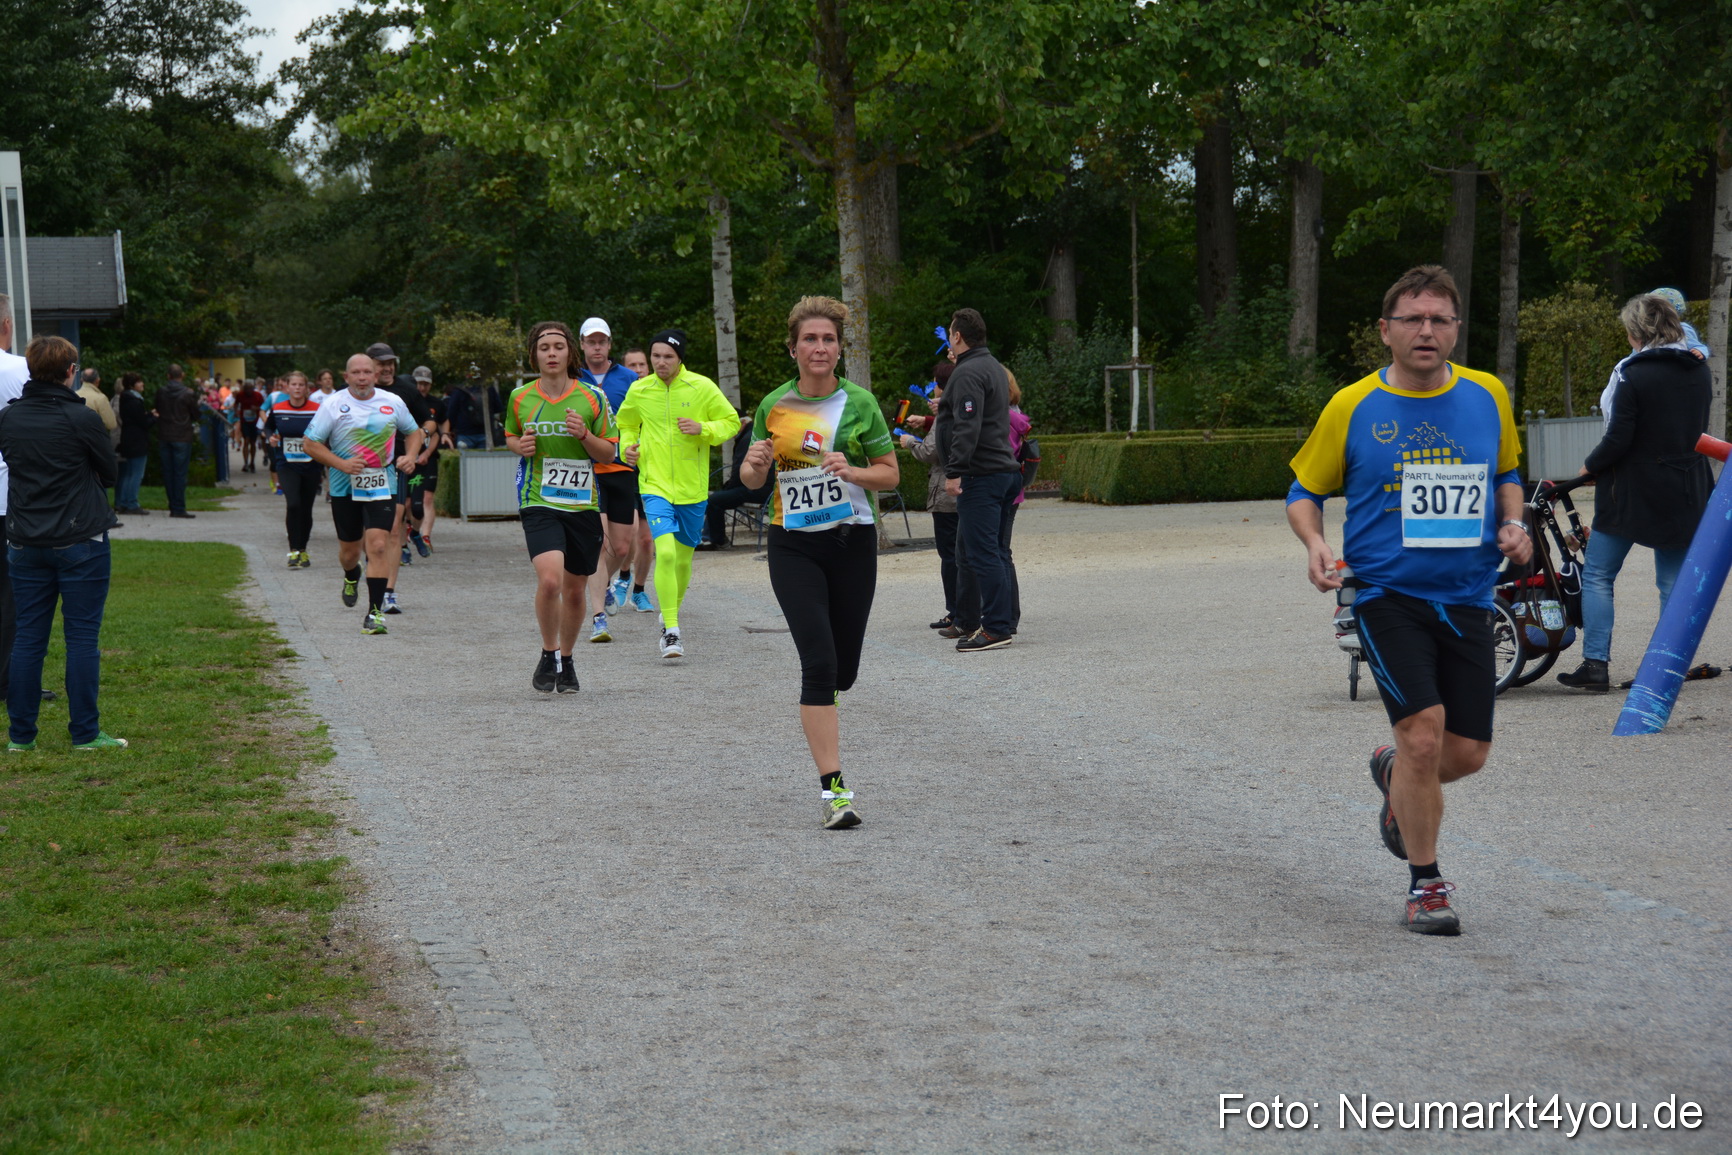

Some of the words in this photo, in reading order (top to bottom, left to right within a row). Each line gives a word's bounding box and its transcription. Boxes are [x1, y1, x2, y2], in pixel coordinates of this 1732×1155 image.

[355, 474, 385, 489] 2256
[547, 468, 590, 488] 2747
[779, 476, 799, 484] PARTL
[556, 490, 578, 498] Simon
[787, 479, 843, 510] 2475
[1411, 484, 1481, 515] 3072
[805, 513, 831, 525] Silvia
